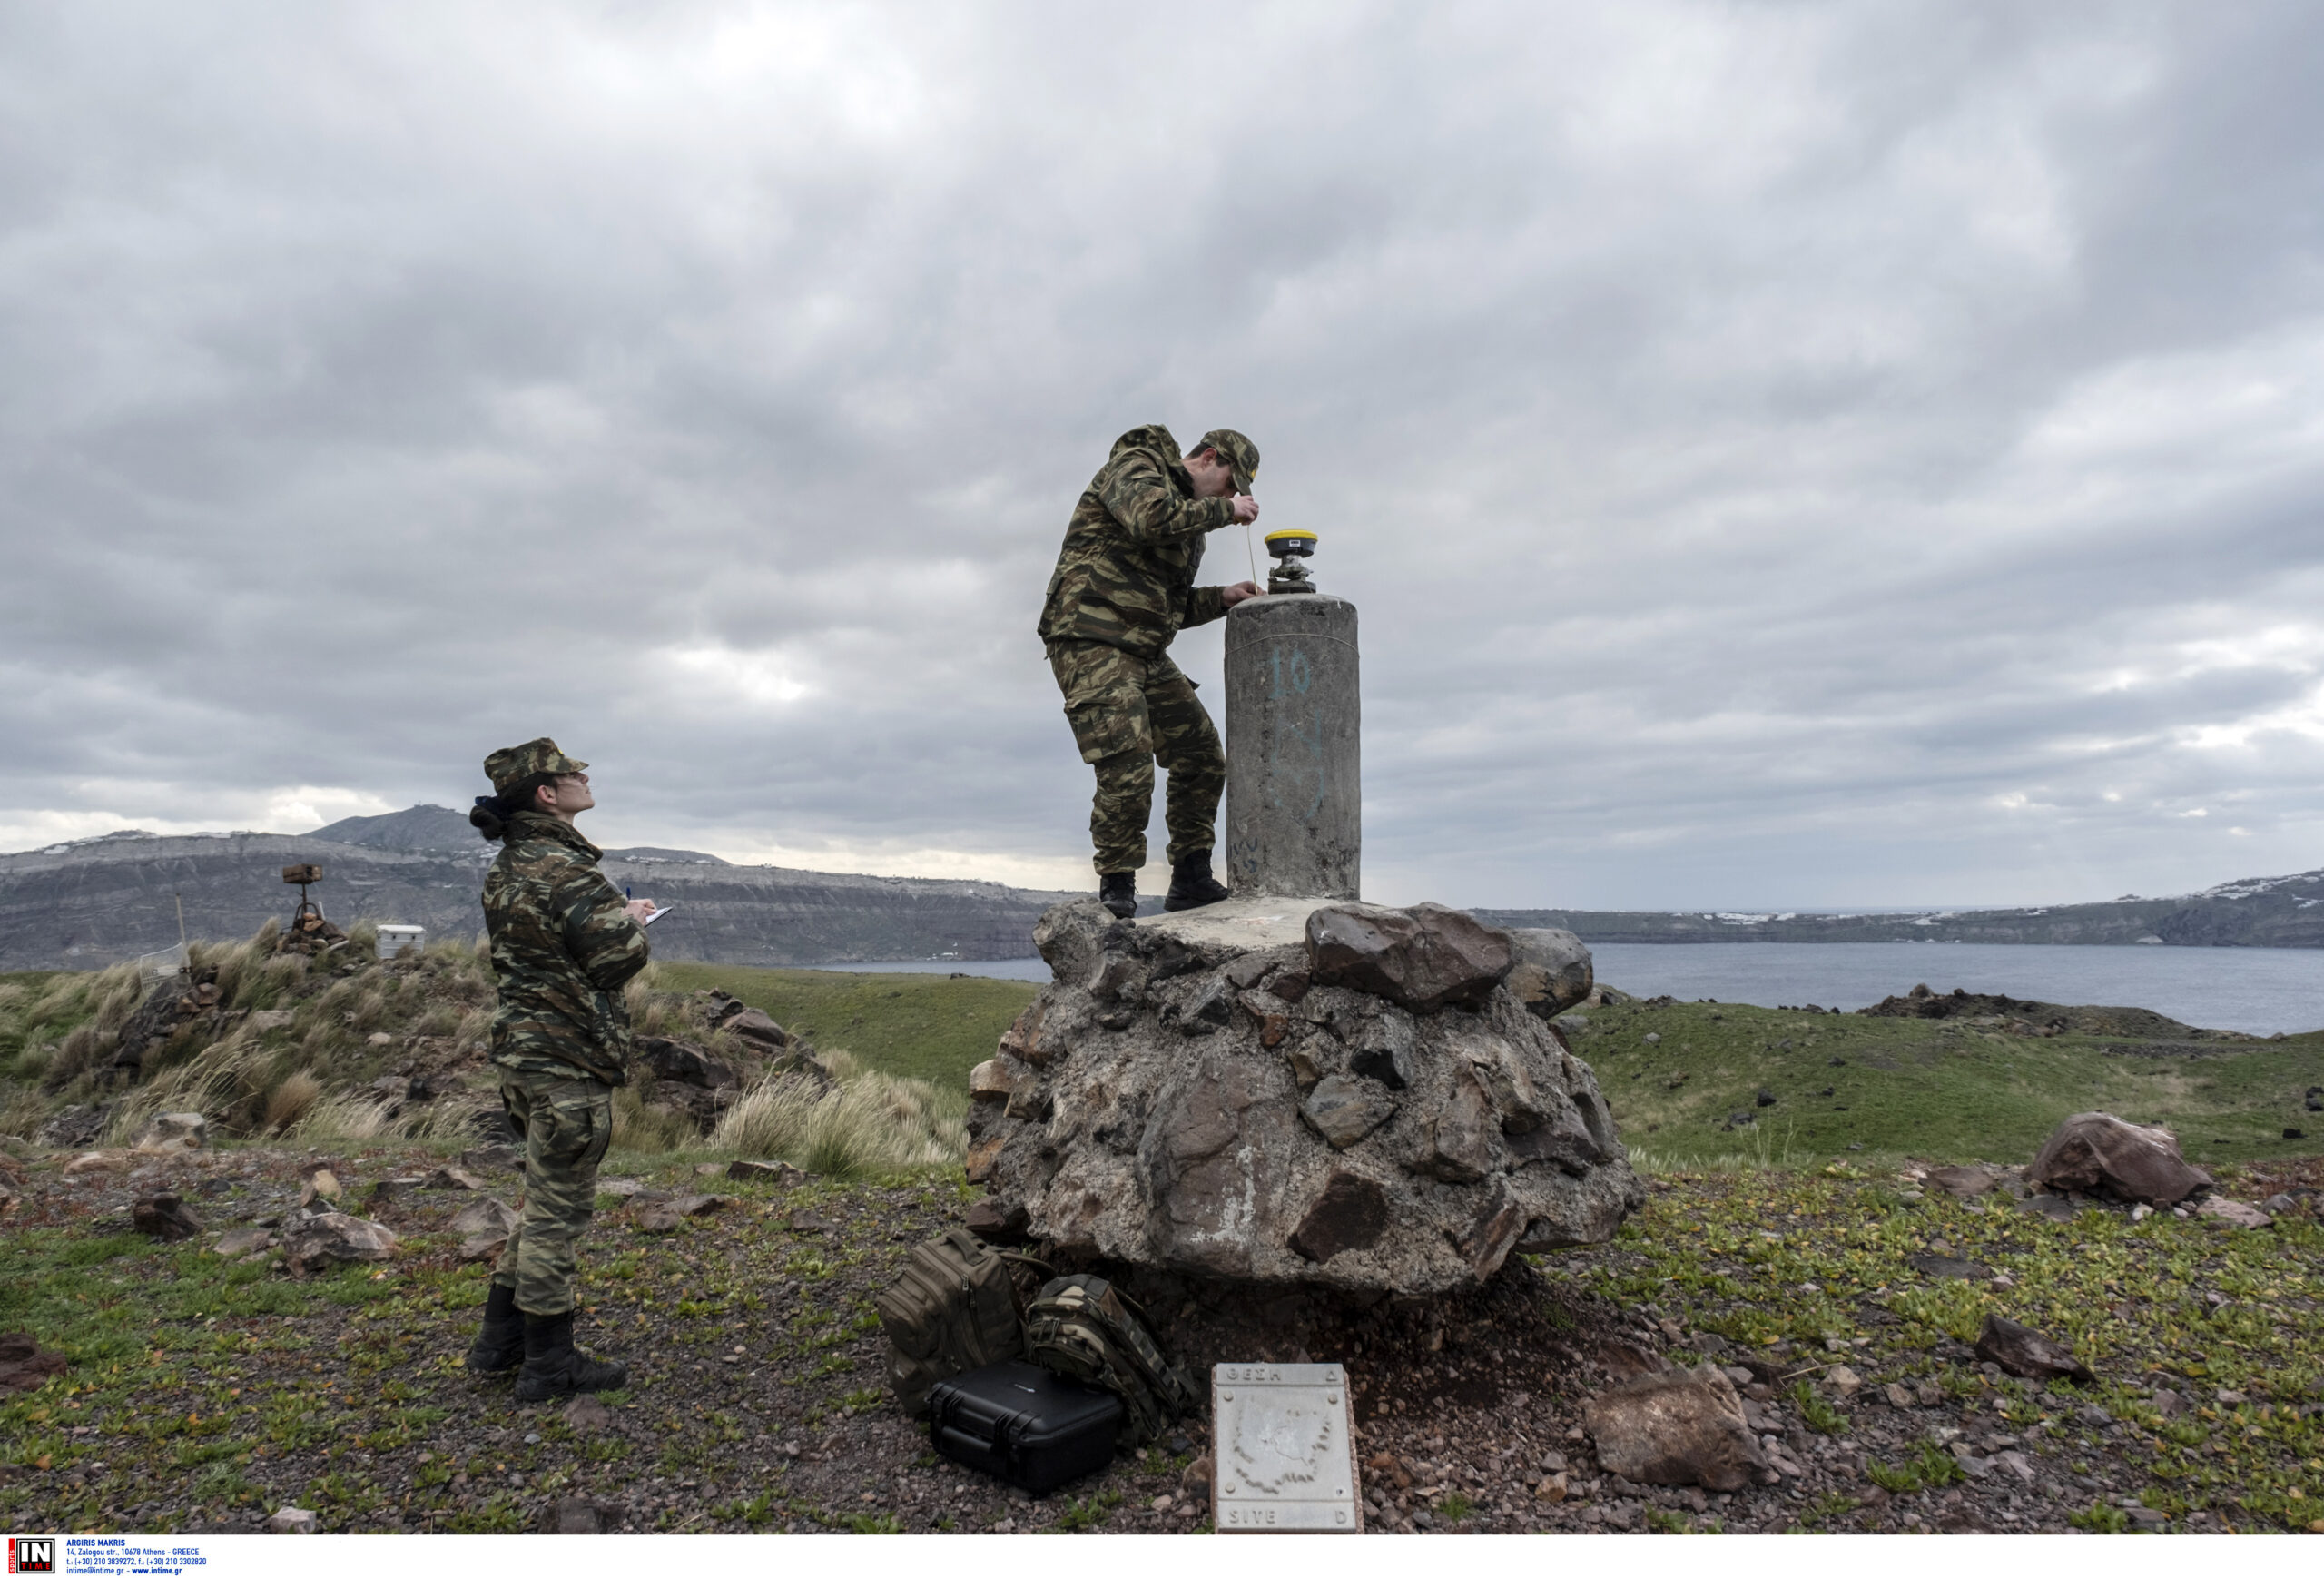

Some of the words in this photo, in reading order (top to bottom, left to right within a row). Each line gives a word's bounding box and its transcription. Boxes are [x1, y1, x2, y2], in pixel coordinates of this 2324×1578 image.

[1267, 646, 1312, 699] 10
[1229, 1511, 1276, 1524] SITE
[1335, 1511, 1347, 1524] D
